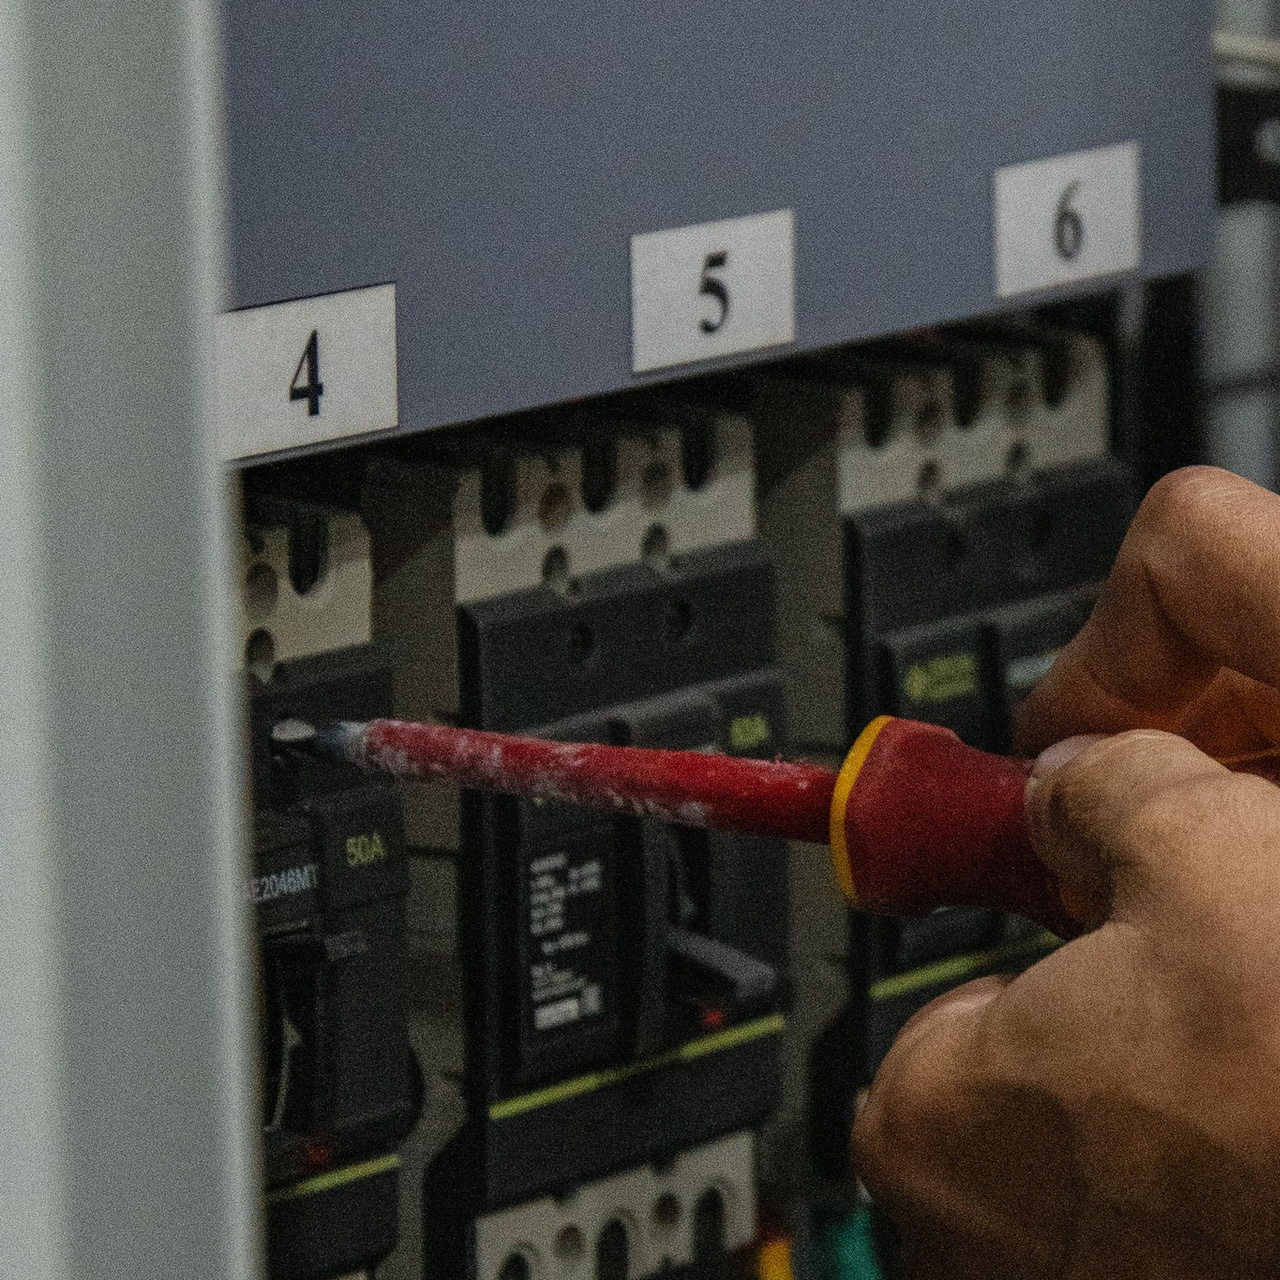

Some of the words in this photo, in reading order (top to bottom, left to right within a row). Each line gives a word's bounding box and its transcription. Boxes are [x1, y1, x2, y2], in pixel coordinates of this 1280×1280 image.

[1052, 180, 1085, 263] 6
[698, 251, 731, 335] 5
[288, 328, 325, 418] 4
